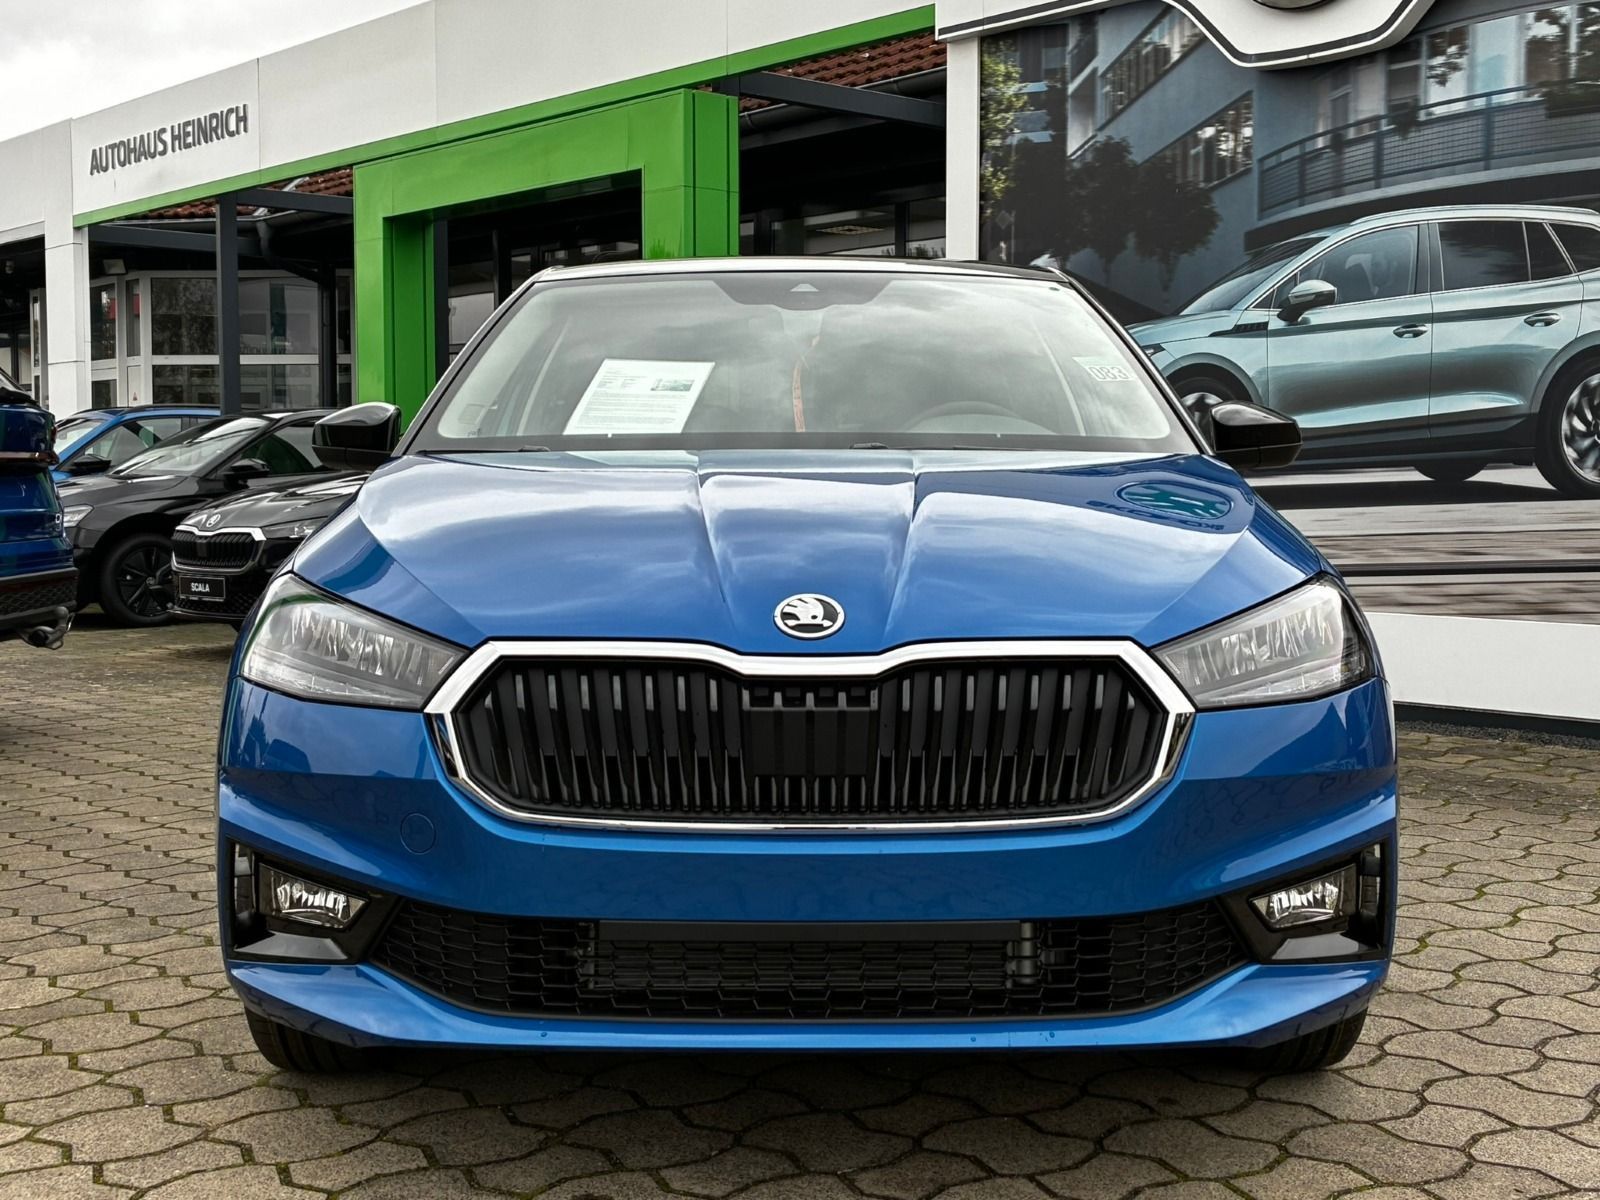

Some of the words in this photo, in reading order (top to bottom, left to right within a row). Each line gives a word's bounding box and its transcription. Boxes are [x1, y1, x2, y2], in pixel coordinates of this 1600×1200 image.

[89, 127, 168, 176] AUTOHAUS
[170, 103, 249, 153] HEINRICH
[1088, 366, 1130, 380] 083
[191, 582, 210, 592] SCALA
